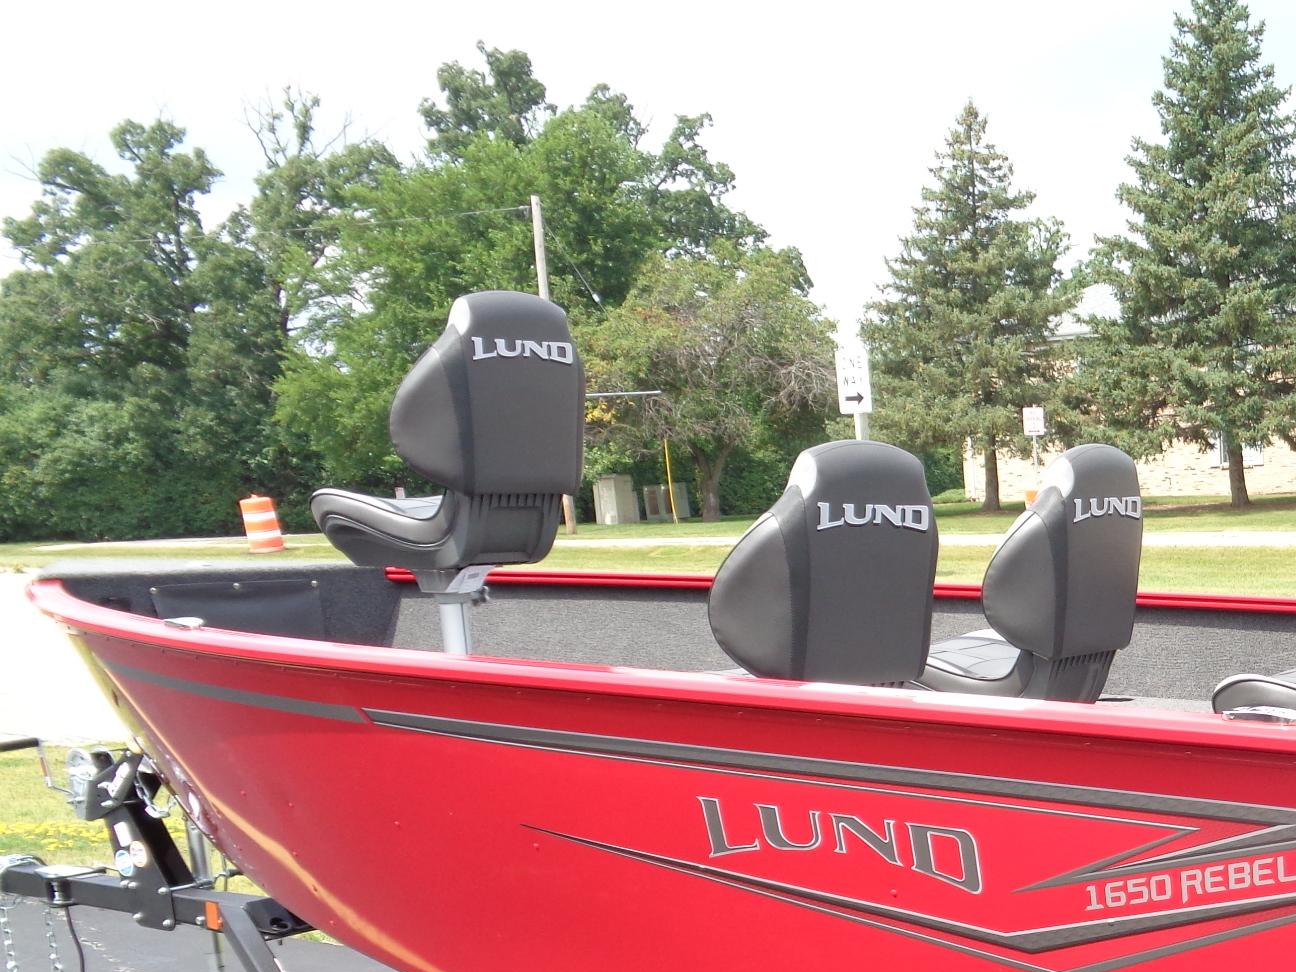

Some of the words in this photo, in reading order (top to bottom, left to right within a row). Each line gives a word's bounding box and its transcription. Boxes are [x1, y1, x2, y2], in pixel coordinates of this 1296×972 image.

[471, 336, 574, 365] LUND
[816, 501, 930, 531] LUND
[1073, 496, 1141, 523] LUND
[696, 795, 983, 895] LUND
[1085, 868, 1171, 911] 1650
